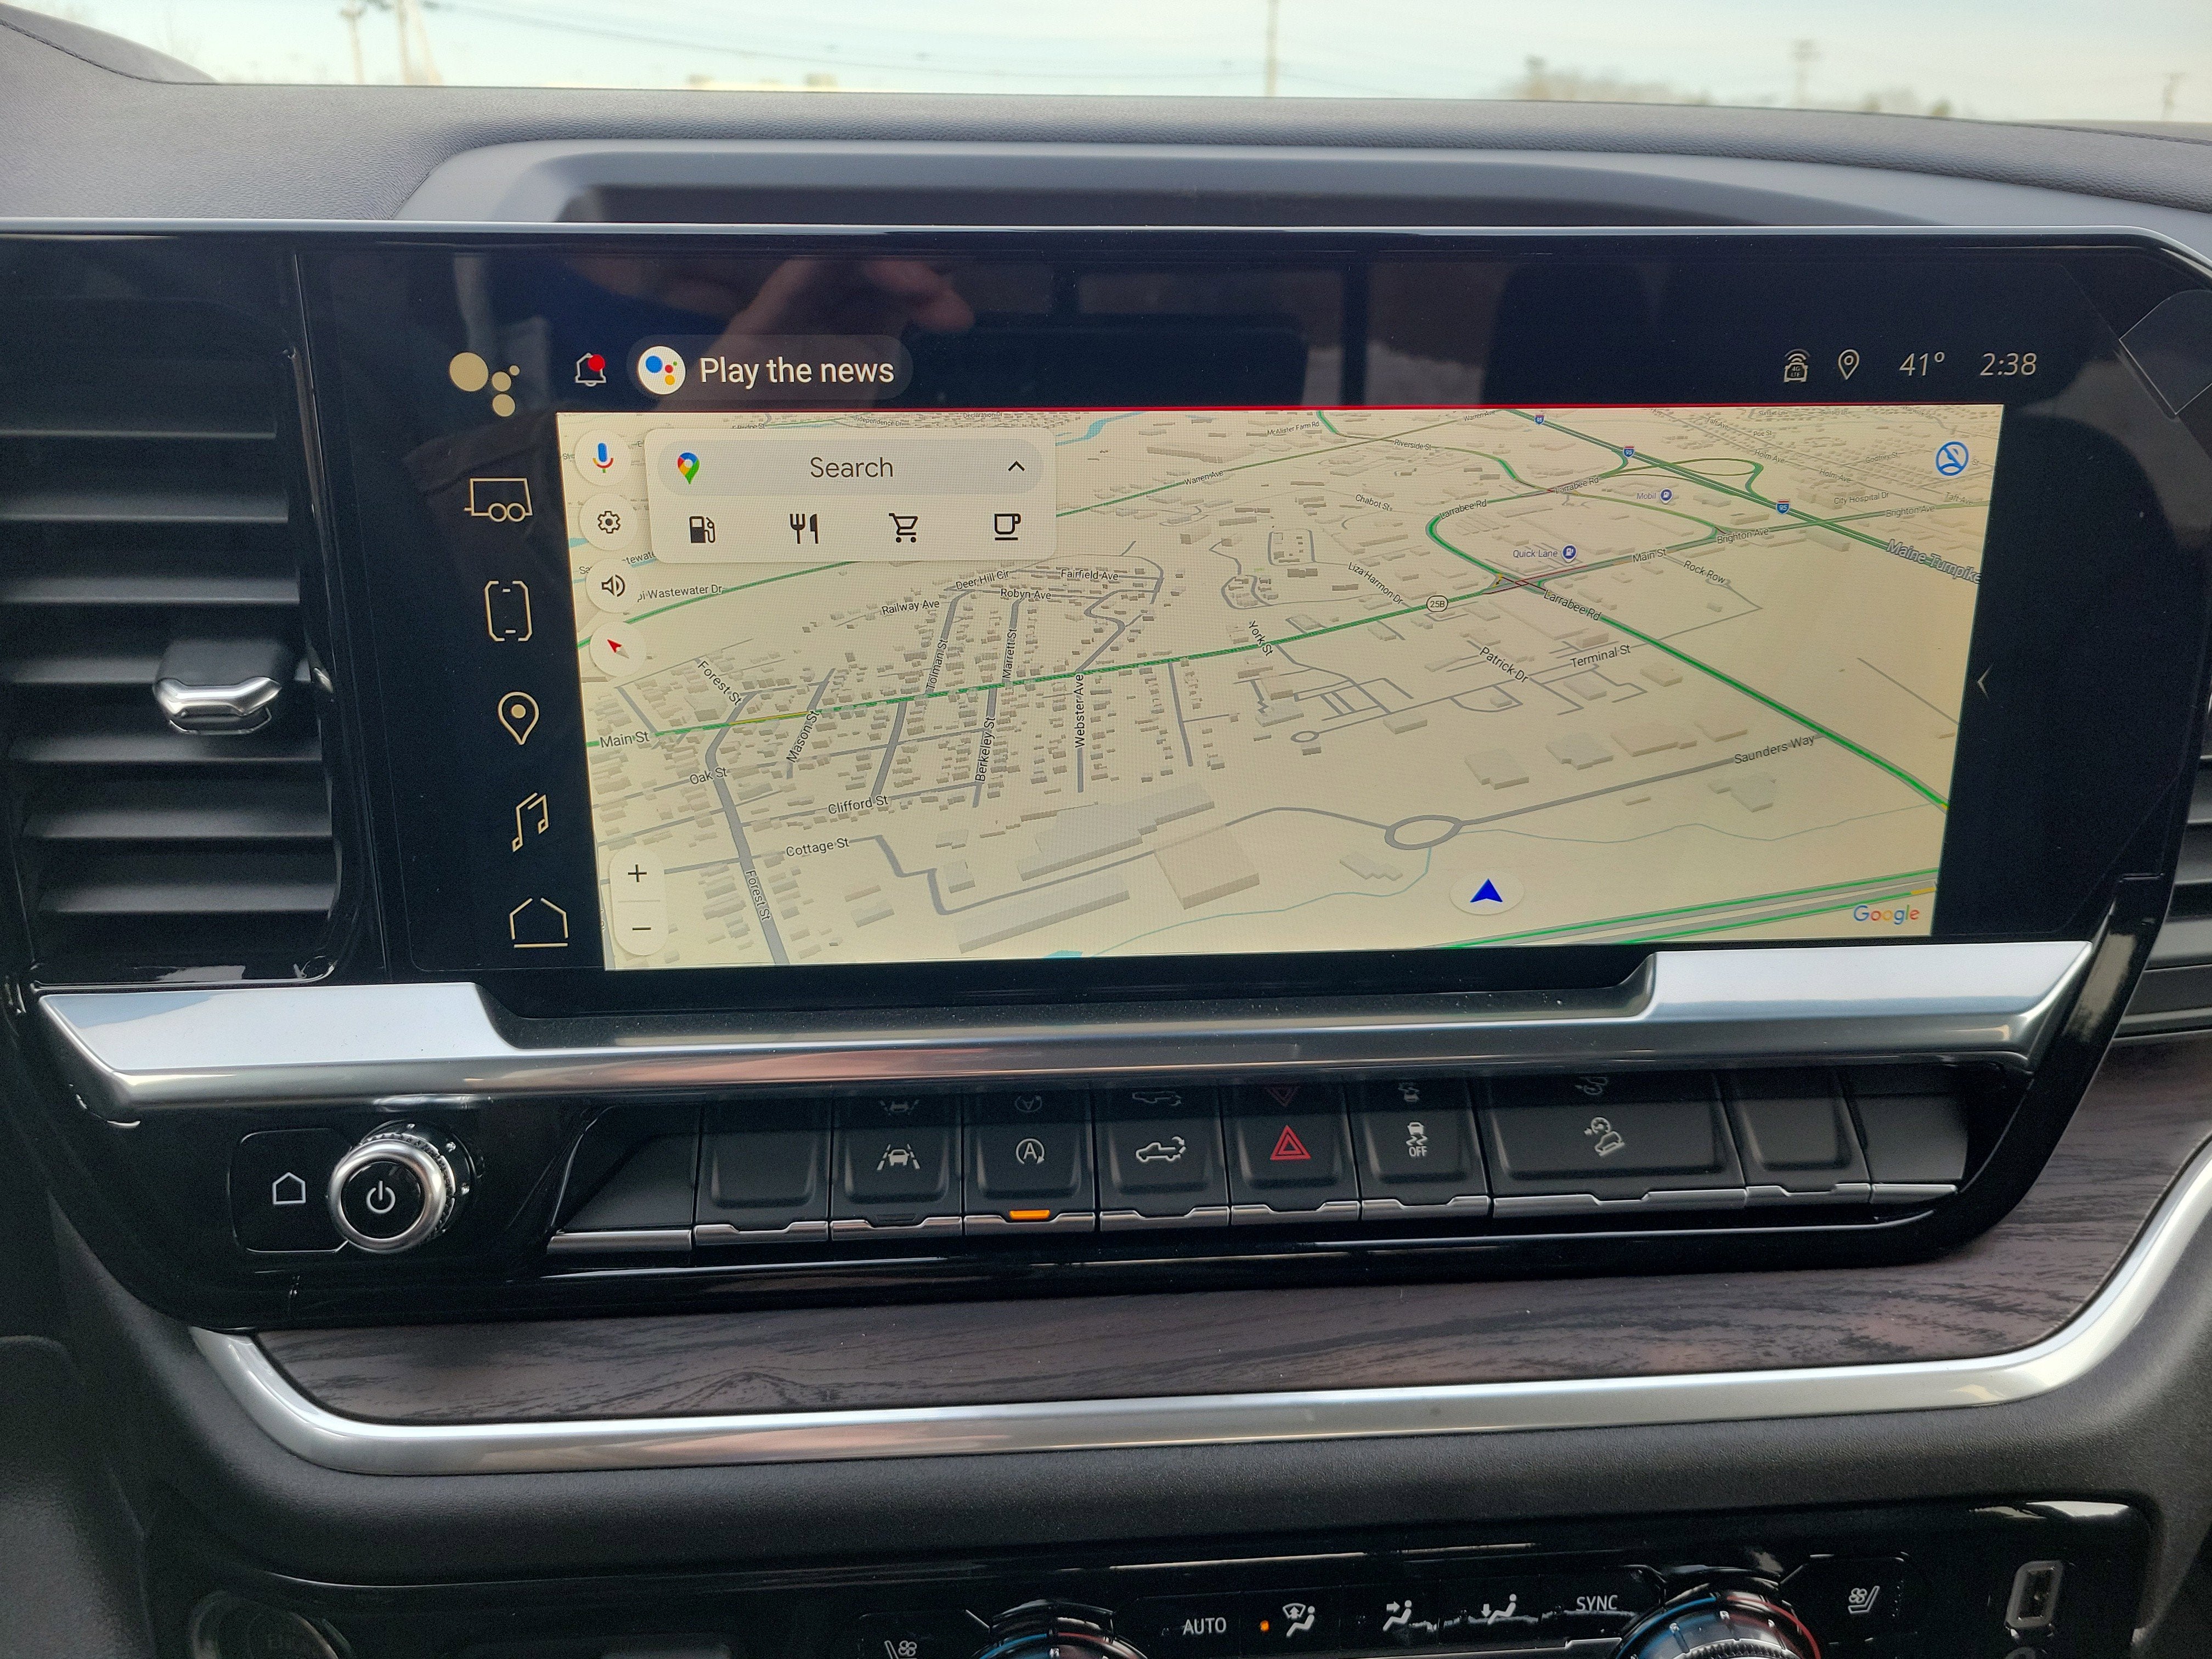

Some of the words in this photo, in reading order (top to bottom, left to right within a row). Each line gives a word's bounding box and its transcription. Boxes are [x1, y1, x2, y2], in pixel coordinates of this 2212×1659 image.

[1980, 352, 2037, 376] 2:38
[699, 357, 759, 390] Play
[766, 357, 811, 383] the
[821, 363, 894, 383] news
[1394, 439, 1424, 449] Riverside
[1754, 449, 1771, 459] Holm
[1772, 455, 1785, 464] Ave
[810, 457, 893, 478] Search
[1819, 469, 1838, 481] Holm
[1839, 474, 1852, 483] Ave
[1184, 473, 1210, 486] Warren
[1211, 470, 1224, 479] Ave
[1555, 481, 1587, 494] Larrabee
[1589, 477, 1599, 485] Rd
[1355, 494, 1381, 509] Chabot
[1382, 503, 1390, 511] St
[1834, 496, 1847, 505] City
[1849, 493, 1880, 504] Hospital
[1440, 502, 1475, 520] Larrabee
[1476, 499, 1487, 509] Rd
[1886, 506, 1918, 517] Brighton
[1920, 504, 1934, 513] Ave
[1717, 531, 1752, 544] Brighton
[1754, 528, 1769, 537] Ave
[1513, 549, 1537, 559] Quick
[1633, 551, 1655, 563] Main
[1657, 549, 1667, 558] St
[1887, 539, 1926, 564] Maine
[956, 578, 978, 590] Deer
[979, 573, 996, 584] Hill
[997, 570, 1009, 580] Cir
[1061, 569, 1099, 580] Fairfield
[1101, 572, 1119, 580] Ave
[1683, 561, 1705, 577] Rock
[1706, 571, 1726, 584] Row
[647, 585, 709, 599] Wastewater
[711, 584, 722, 594] Dr
[1348, 562, 1365, 576] Liza
[1364, 570, 1394, 598] Harmon
[1392, 593, 1403, 605] Dr
[1000, 589, 1030, 599] Robyn
[1034, 590, 1051, 599] Ave
[882, 602, 919, 615] Railway
[922, 600, 940, 609] Ave
[1430, 600, 1445, 608] 25B
[1544, 590, 1586, 614] Larrabee
[1585, 607, 1601, 621] Rd
[1008, 628, 1017, 639] St
[1249, 620, 1265, 645] York
[1262, 643, 1274, 657] St
[926, 652, 944, 690] Tolman
[938, 638, 948, 650] St
[1003, 641, 1015, 679] Marrett
[1480, 647, 1516, 675] Patrick
[1514, 669, 1530, 683] Dr
[1570, 648, 1618, 668] Terminal
[1620, 645, 1630, 654] St
[697, 660, 731, 695] Forest
[729, 692, 742, 706] St
[1074, 674, 1084, 696] Ave
[984, 716, 996, 729] St
[1074, 700, 1085, 748] Webster
[600, 734, 632, 748] Main
[635, 731, 650, 743] St
[786, 725, 812, 763] Mason
[806, 710, 819, 723] St
[975, 731, 995, 782] Berkeley
[1734, 742, 1788, 764] Saunders
[1790, 735, 1815, 749] Way
[690, 771, 713, 785] Oak
[715, 768, 727, 778] St
[828, 798, 872, 815] Clifford
[876, 795, 889, 806] St
[786, 842, 834, 857] Cottage
[837, 837, 850, 849] St
[745, 870, 766, 907] Forest
[759, 908, 771, 921] St
[1853, 904, 1920, 924] Google
[1023, 1143, 1037, 1159] A
[1409, 1146, 1427, 1156] OFF
[1576, 1595, 1618, 1611] SYNC
[1183, 1618, 1227, 1635] AUTO
